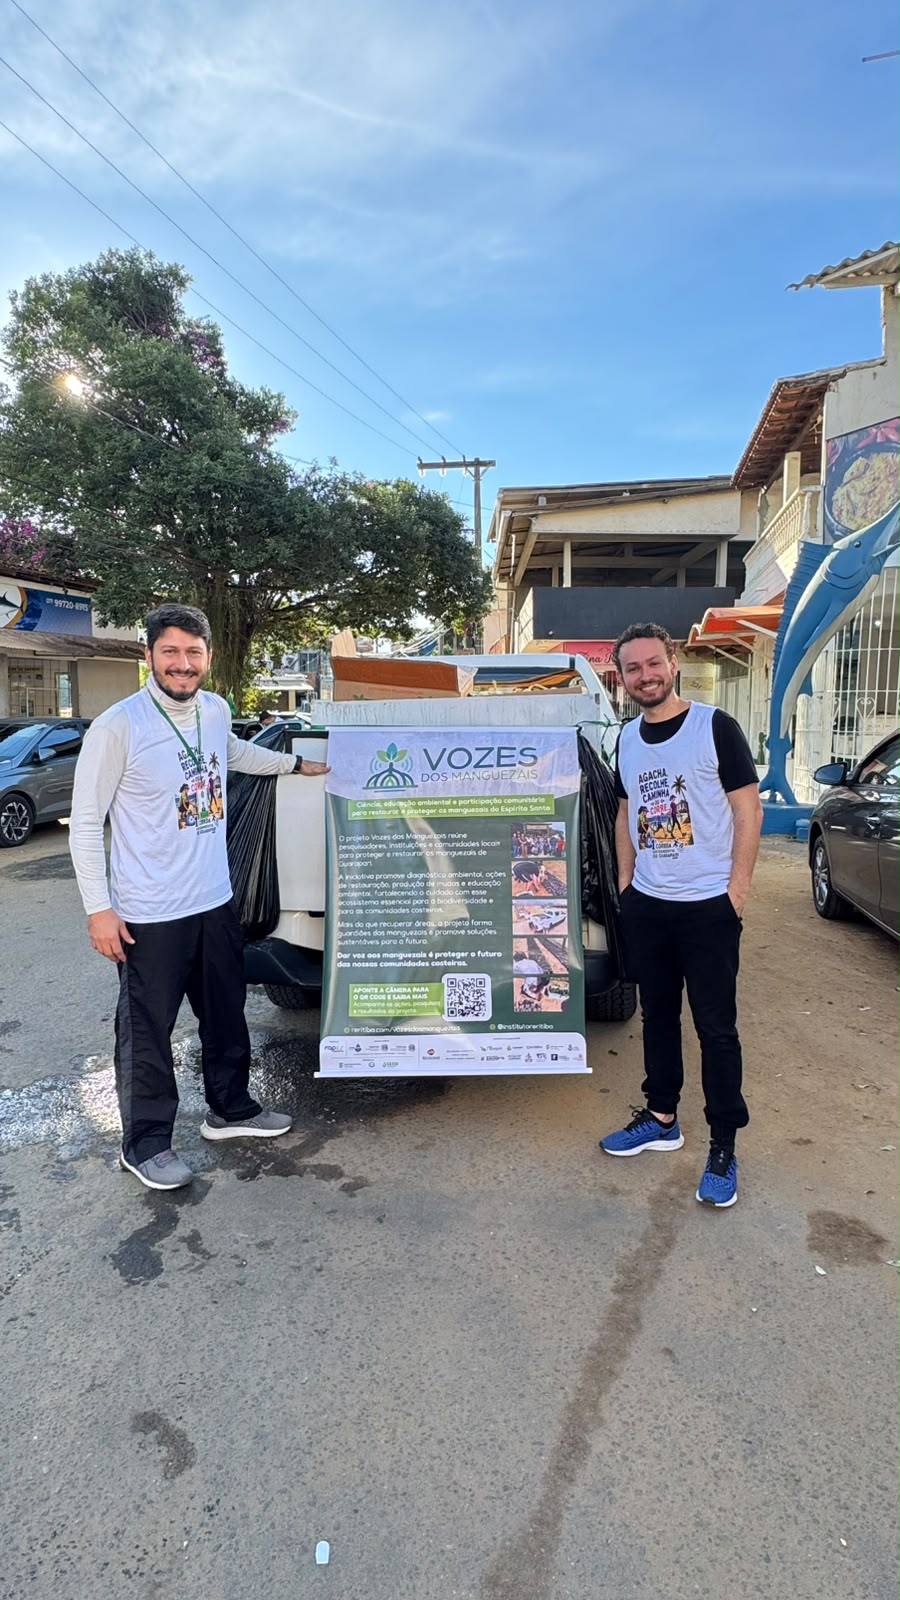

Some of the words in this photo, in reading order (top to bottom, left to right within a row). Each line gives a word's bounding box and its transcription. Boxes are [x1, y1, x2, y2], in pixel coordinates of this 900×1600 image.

[423, 747, 538, 770] VOZES
[421, 773, 448, 782] DOS
[452, 769, 538, 781] MANGUEZAIS
[642, 789, 669, 803] CAMINHA
